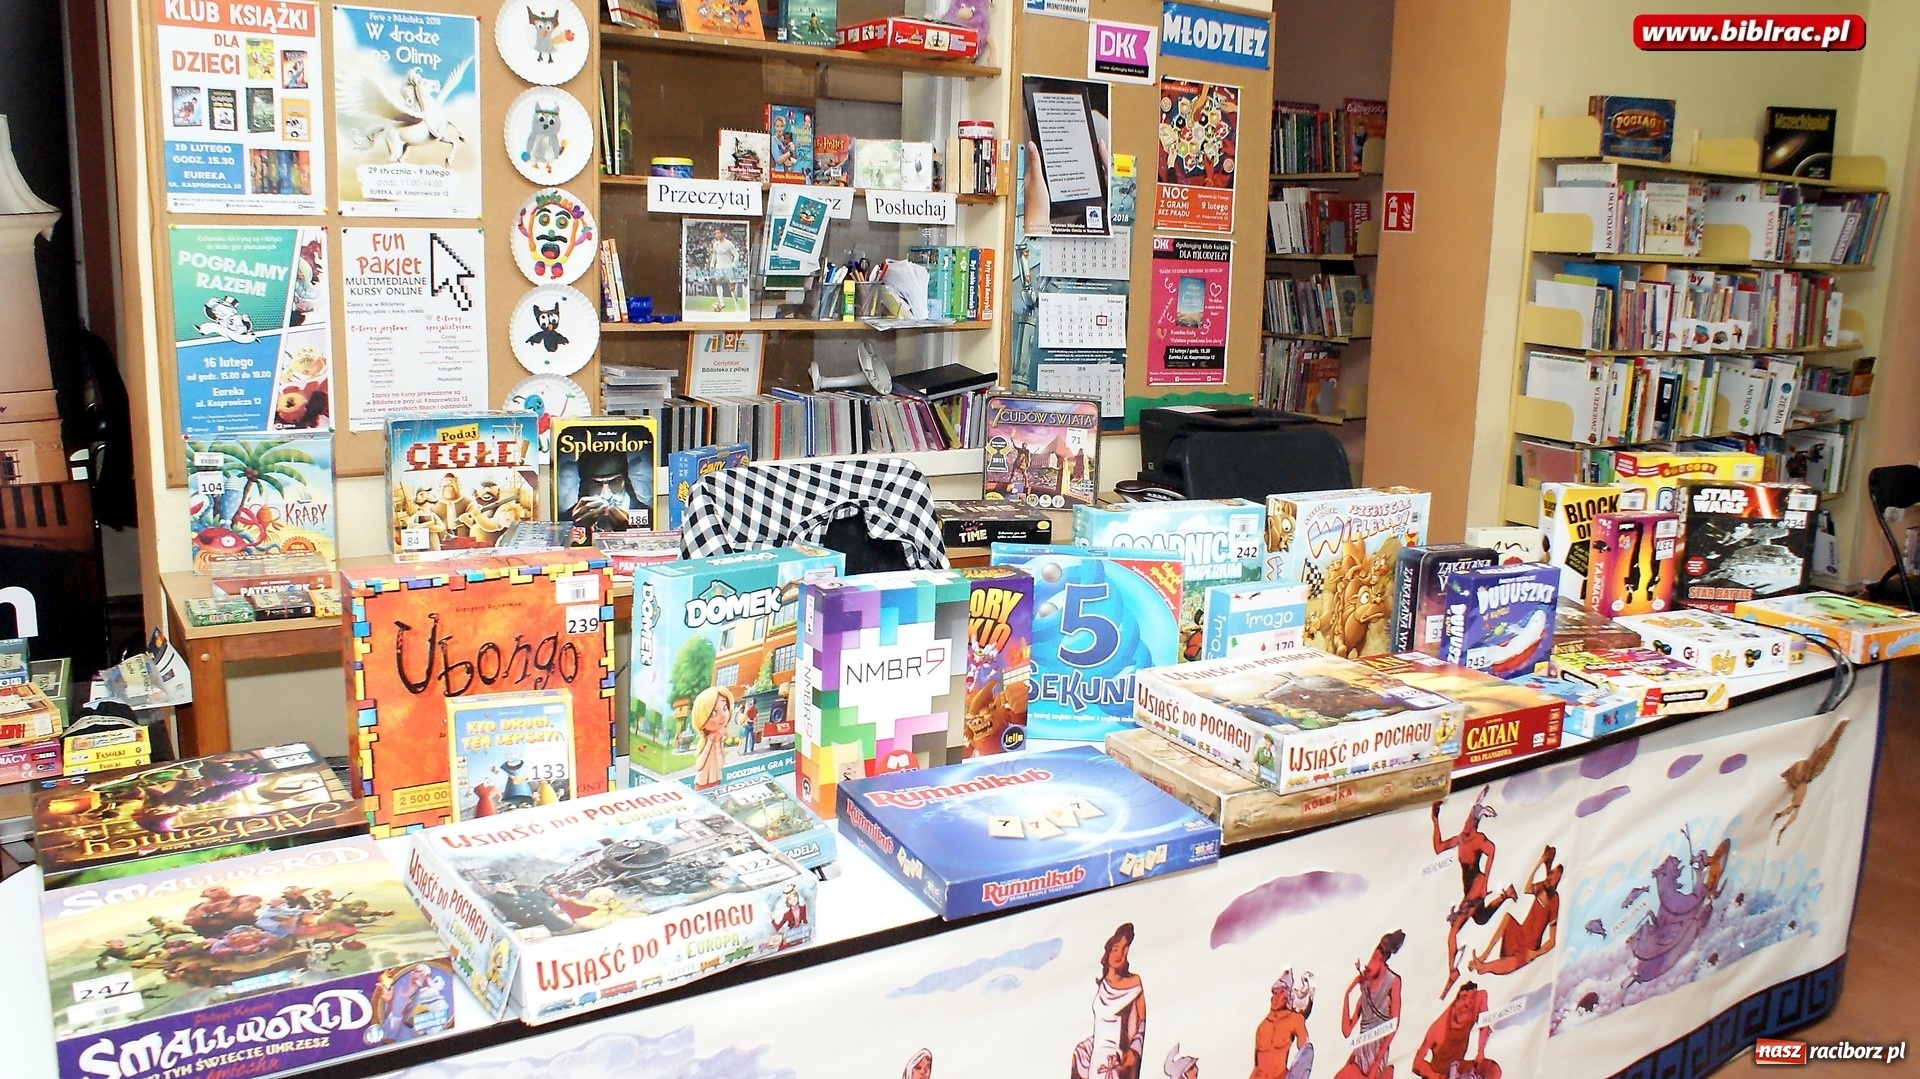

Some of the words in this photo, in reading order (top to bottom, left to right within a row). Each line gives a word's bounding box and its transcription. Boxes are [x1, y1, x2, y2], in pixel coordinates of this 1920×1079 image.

[164, 0, 220, 23] KLUB
[230, 2, 308, 33] KSIĄŻKI
[214, 33, 240, 48] DLA
[366, 22, 384, 40] W
[390, 24, 440, 46] drodze
[172, 50, 240, 75] DZIECI
[396, 46, 442, 71] Olimp
[174, 143, 188, 152] 19
[190, 144, 232, 154] LUTEGO
[208, 156, 235, 166] 15.30
[184, 171, 226, 180] EUREKA
[658, 183, 752, 215] Przeczytaj
[1162, 186, 1190, 200] NOC
[875, 197, 947, 221] Posłuchaj
[1160, 200, 1164, 208] Z
[1166, 201, 1190, 209] GRAMI
[1170, 209, 1190, 218] PRĄDU
[1201, 201, 1206, 209] 9
[1208, 202, 1229, 212] lutego
[1112, 213, 1129, 222] 2018
[1605, 191, 1615, 250] NASTOLATKI
[1765, 210, 1775, 248] SZTUKA
[1179, 250, 1192, 259] DLA
[178, 249, 290, 282] POGRAJMY
[196, 271, 268, 298] RAZEM!
[345, 277, 428, 286] MULTIMEDIALNE
[350, 287, 383, 296] KURSY
[386, 287, 423, 296] ONLINE
[203, 357, 216, 368] 16
[219, 356, 254, 370] lutego
[213, 386, 245, 396] Eureka
[991, 404, 1006, 427] 7
[1590, 385, 1601, 434] ZWIERZĘTA
[1773, 394, 1789, 425] ZIEMIA
[440, 426, 477, 442] Podaj
[1071, 435, 1082, 445] 71
[560, 429, 651, 461] Splendor
[202, 480, 222, 493] 104
[1699, 488, 1749, 501] STAR
[285, 502, 328, 527] KRABY
[1693, 500, 1748, 514] WARS
[630, 515, 648, 525] 186
[406, 536, 421, 548] 84
[958, 529, 988, 543] TIME
[1236, 546, 1258, 559] 242
[1591, 561, 1604, 612] TAJNIACY
[1688, 587, 1717, 600] STAR
[684, 586, 782, 629] DOMEK
[567, 618, 599, 634] 239
[638, 581, 656, 667] DOMEK
[1056, 582, 1121, 669] 5
[1245, 608, 1294, 630] imago
[393, 611, 581, 697] Ubongo
[1467, 656, 1486, 669] 243
[466, 720, 497, 735] KTO
[1182, 710, 1197, 726] DO
[1200, 710, 1253, 754] POCIĄGU
[1466, 719, 1521, 751] CATAN
[461, 735, 492, 751] TEN
[495, 730, 560, 746] LEPSZY!
[1352, 739, 1370, 758] DO
[1374, 721, 1434, 754] POCIĄGU
[95, 749, 126, 760] FASOLKI
[531, 763, 566, 781] 133
[726, 764, 767, 781] RODZINNA
[767, 758, 784, 770] GRA
[743, 791, 773, 803] 156
[868, 767, 1054, 810] Rummikub
[399, 795, 408, 806] 2
[408, 792, 430, 804] 500
[550, 815, 579, 829] DO
[846, 798, 896, 855] Rummikub
[738, 857, 773, 872] 122
[1421, 856, 1454, 876] HERMES
[982, 864, 1087, 907] Rummikub
[437, 888, 450, 909] DO
[632, 938, 660, 966] DO
[685, 933, 741, 960] EUROPA
[79, 980, 130, 999] 247
[1348, 1021, 1396, 1047] ARTEMIDA
[195, 1046, 264, 1072] ŚWIECIE
[265, 1036, 330, 1056] UMRZESZ
